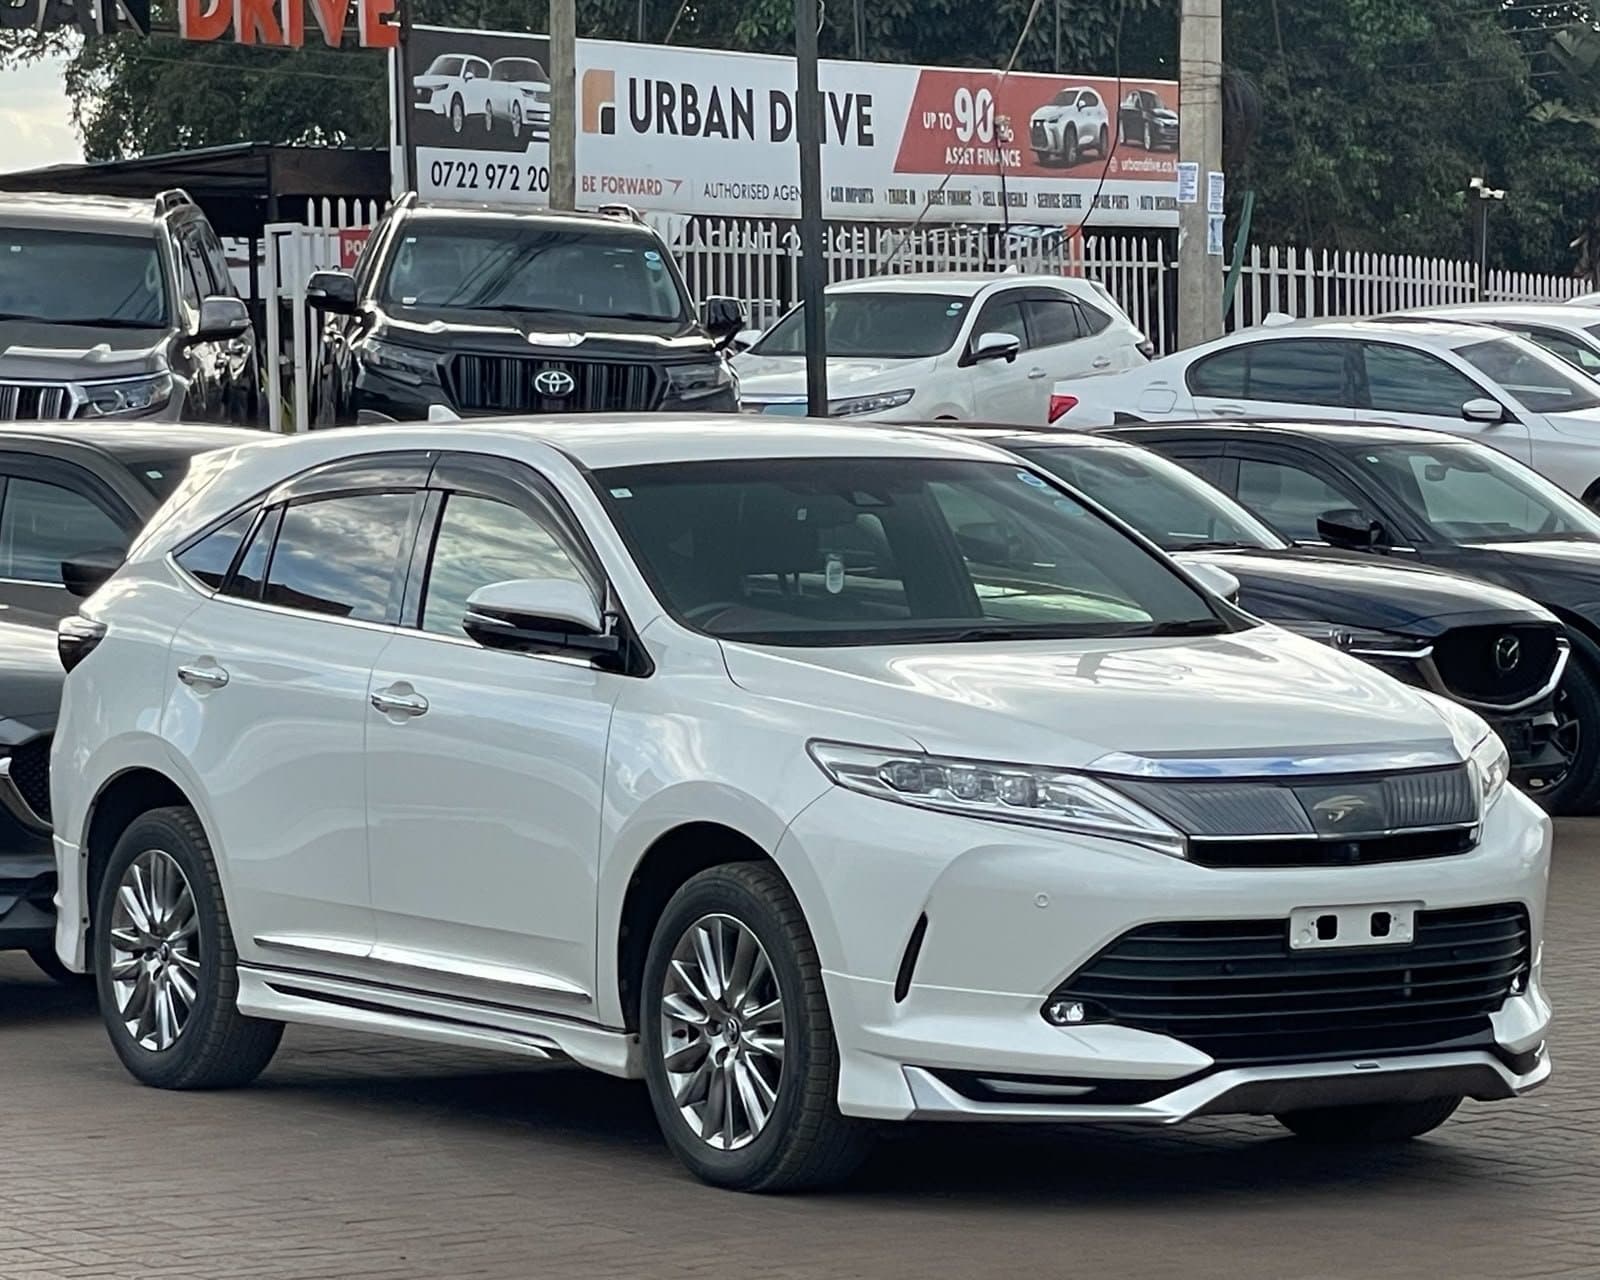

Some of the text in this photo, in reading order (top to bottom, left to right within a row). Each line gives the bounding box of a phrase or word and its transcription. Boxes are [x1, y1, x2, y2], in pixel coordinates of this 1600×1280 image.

[628, 77, 875, 147] URBAN DIVE
[922, 112, 953, 130] UP TO
[945, 147, 1021, 167] ASSET FINANCE
[431, 160, 550, 193] 0722 972 20
[582, 175, 663, 197] BE FORWARD
[704, 183, 801, 201] AUTHORISED AGEN
